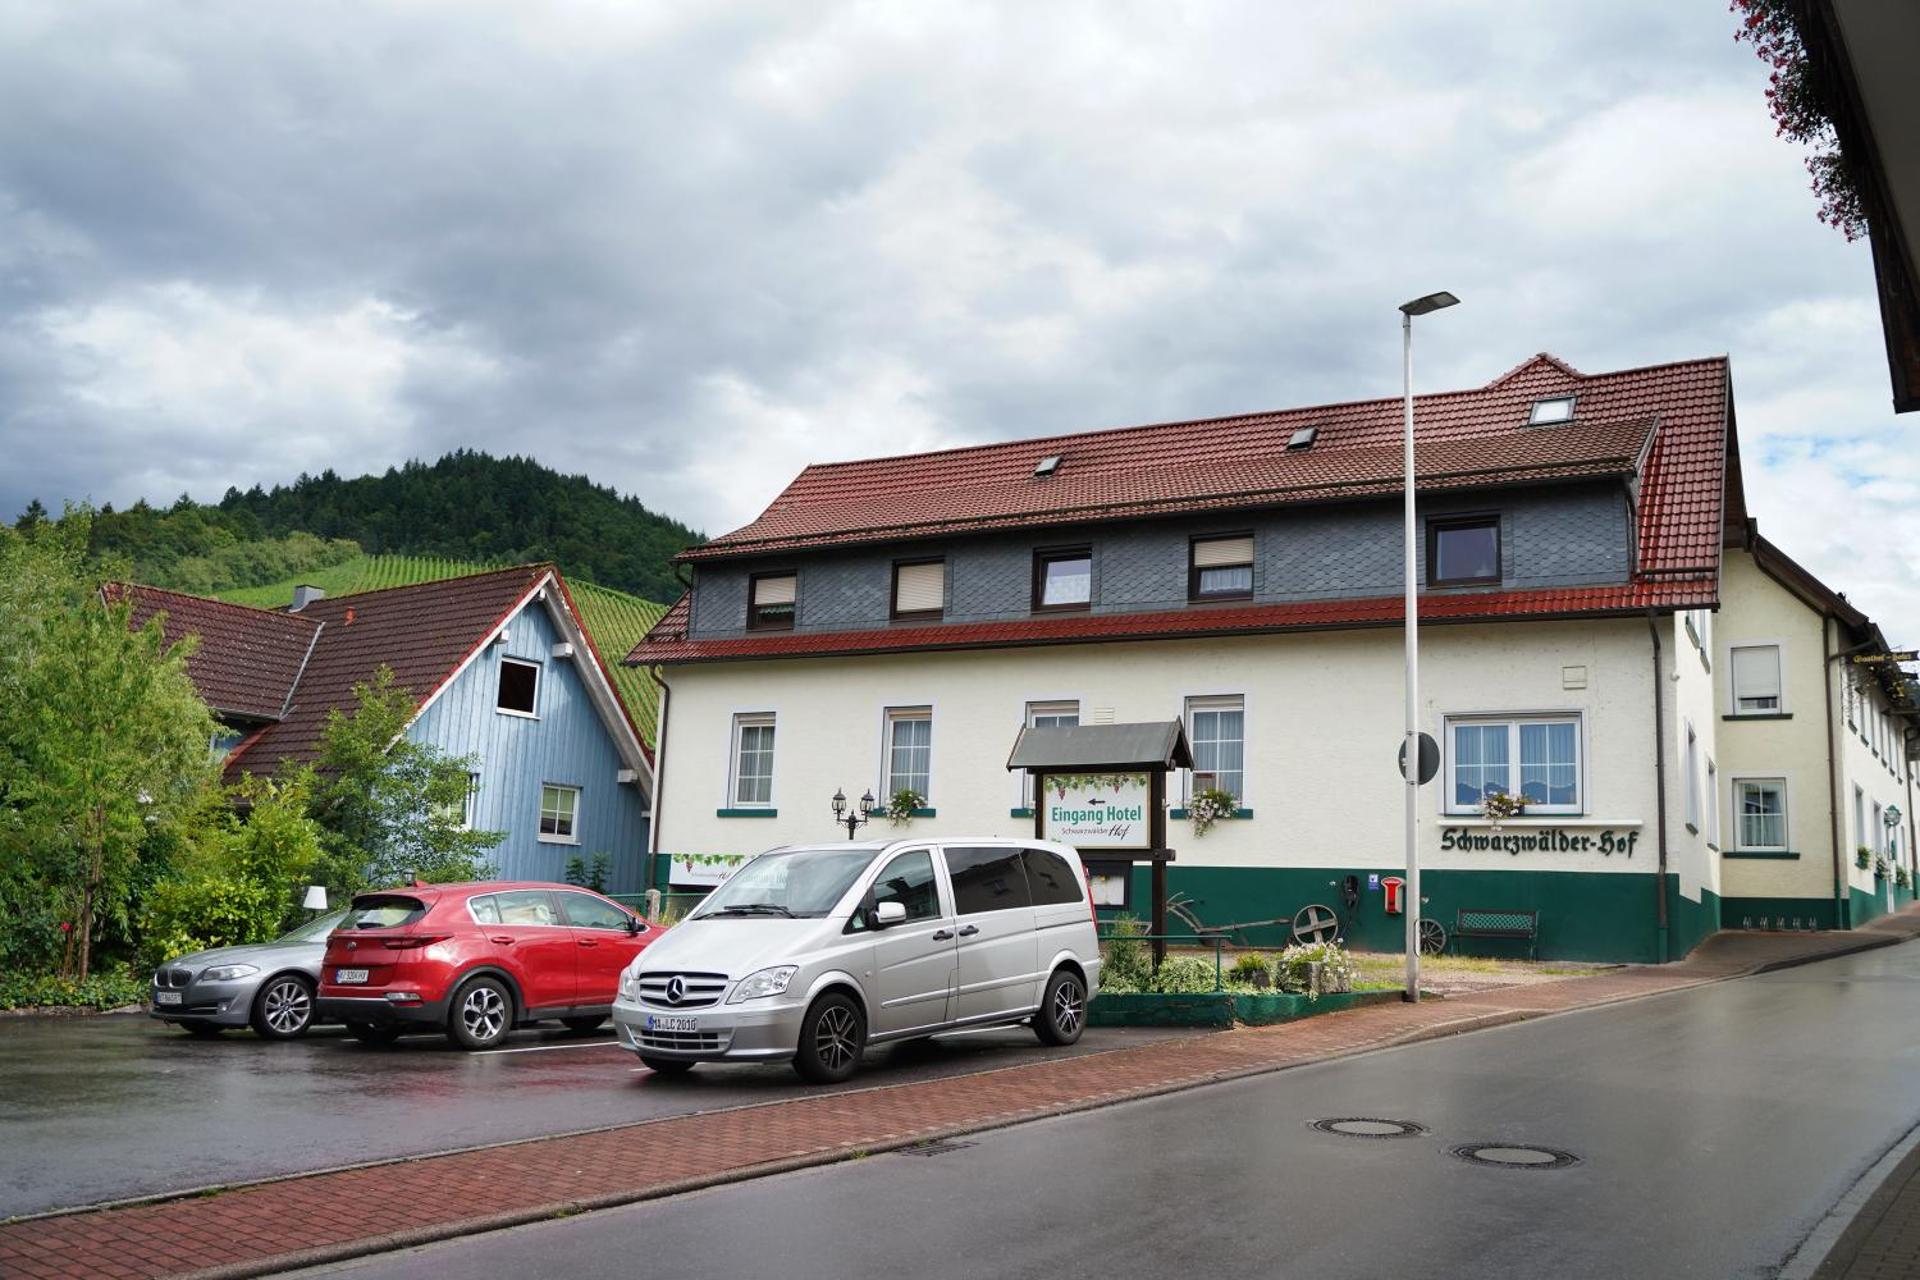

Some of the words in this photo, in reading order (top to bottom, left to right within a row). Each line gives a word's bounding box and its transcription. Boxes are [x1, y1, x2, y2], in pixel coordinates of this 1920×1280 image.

[1052, 806, 1103, 825] Eingang
[1107, 805, 1141, 821] Hotel
[1108, 824, 1131, 840] Hof
[1440, 828, 1639, 858] Schwarzwälder-Hof
[676, 1019, 696, 1031] 2010
